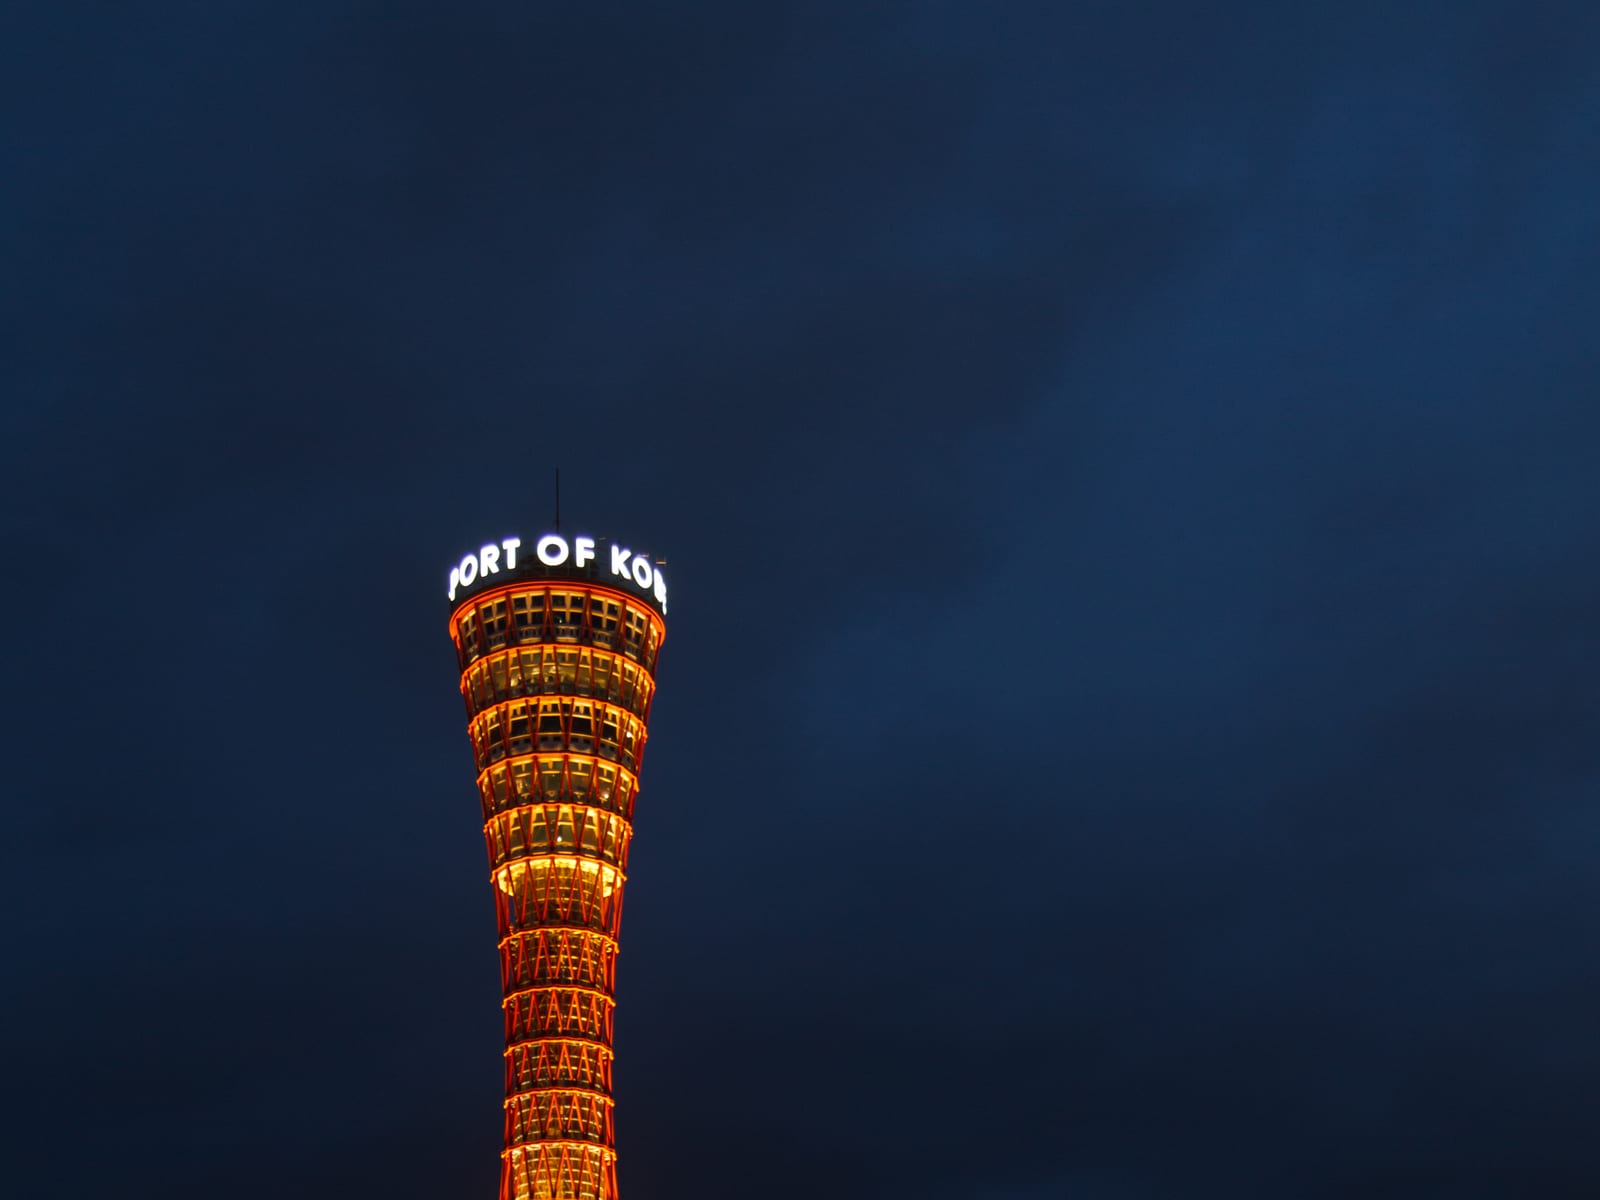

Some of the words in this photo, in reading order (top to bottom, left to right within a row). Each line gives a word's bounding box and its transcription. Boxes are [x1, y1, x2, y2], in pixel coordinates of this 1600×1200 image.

[448, 537, 521, 602] PORT
[537, 535, 595, 568] OF
[611, 544, 667, 616] KOB
